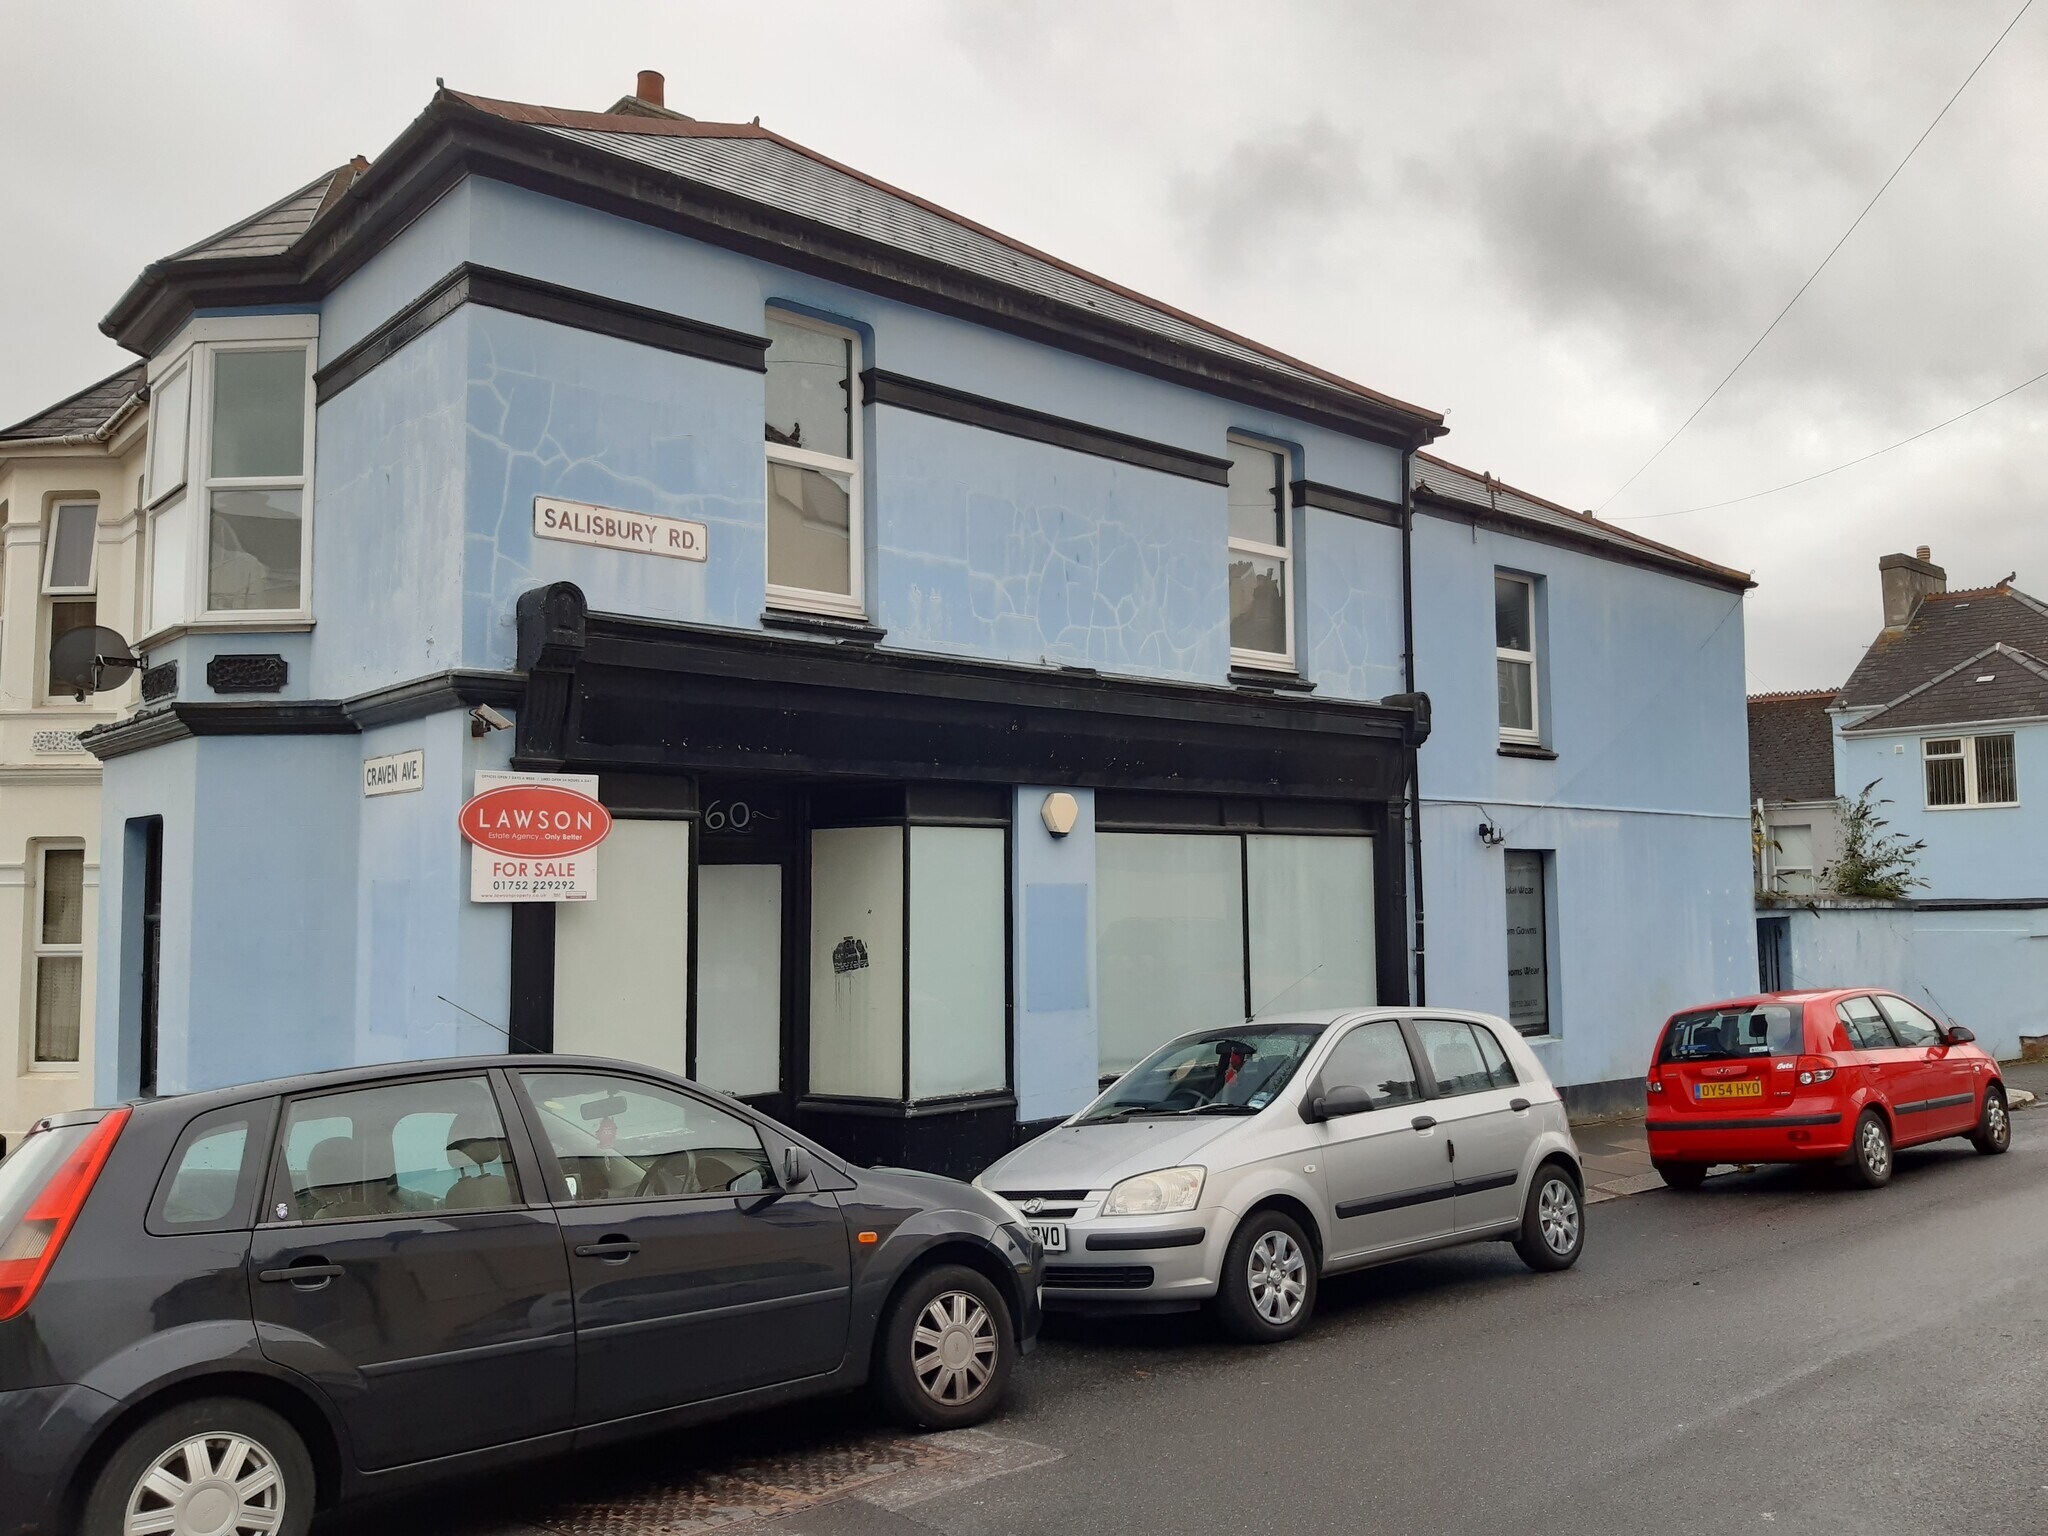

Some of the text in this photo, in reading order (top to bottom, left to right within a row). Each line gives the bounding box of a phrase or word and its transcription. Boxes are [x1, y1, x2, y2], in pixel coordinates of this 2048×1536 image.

[543, 508, 700, 551] SALISBURY RD.
[366, 760, 420, 787] CRAVEN AVE.
[479, 808, 592, 830] LAWSON
[705, 800, 750, 829] 60
[488, 831, 510, 839] Estate
[562, 833, 583, 841] Better
[493, 862, 576, 877] FOR SALE
[493, 880, 575, 890] 01752 229292
[1518, 886, 1534, 894] Wear
[1516, 926, 1537, 935] Gowns
[1523, 966, 1540, 975] Wear
[1702, 1084, 1733, 1096] OY54
[1736, 1082, 1760, 1095] HYO
